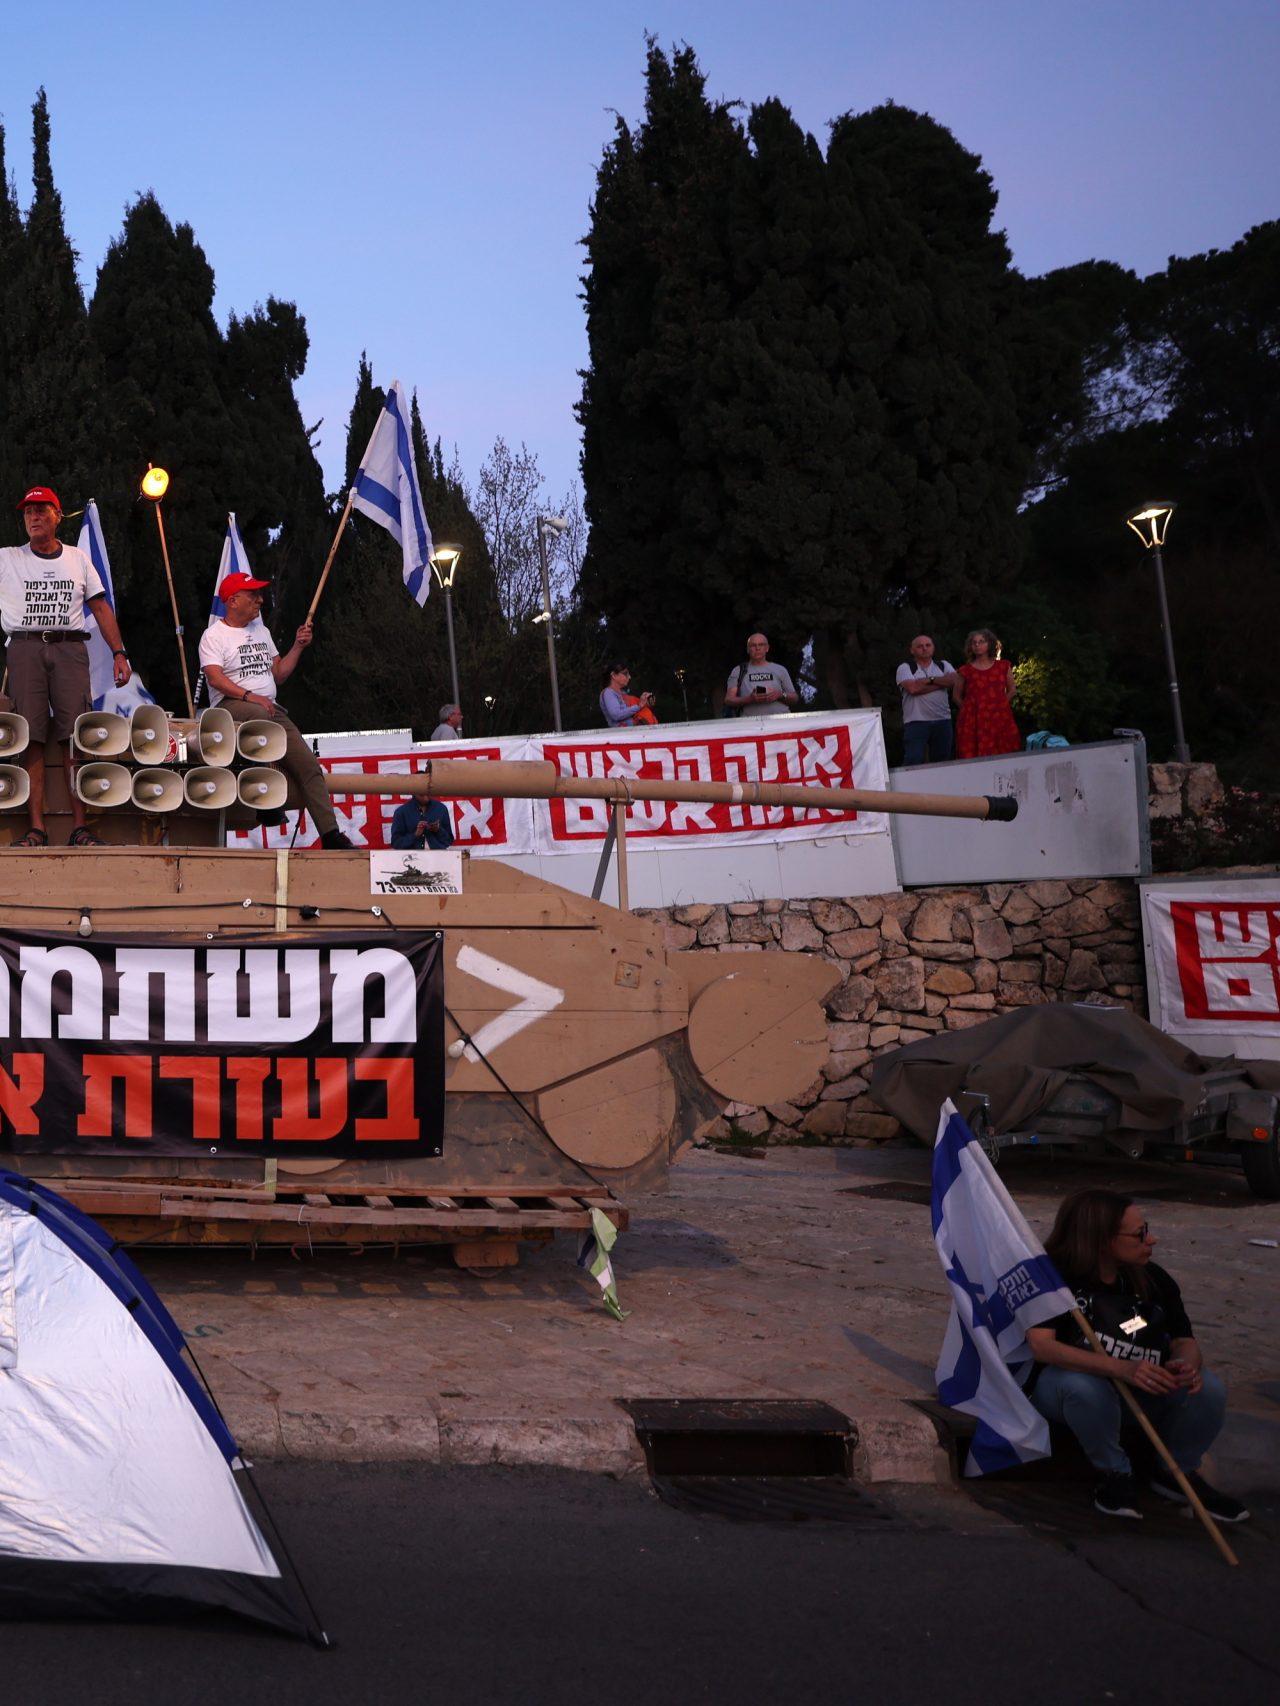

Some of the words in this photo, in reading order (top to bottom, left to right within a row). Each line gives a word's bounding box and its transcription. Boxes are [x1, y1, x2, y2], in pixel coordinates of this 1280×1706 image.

[23, 580, 48, 590] כיפור
[49, 579, 75, 590] לוחמי
[25, 592, 58, 602] נאבקים
[26, 604, 57, 613] דמותה
[58, 602, 70, 613] על
[21, 616, 56, 626] המדינה
[58, 614, 70, 626] של
[722, 734, 842, 783] אתה
[375, 881, 396, 893] 73
[423, 885, 448, 893] לוחמי
[76, 1054, 421, 1141] בעזרת
